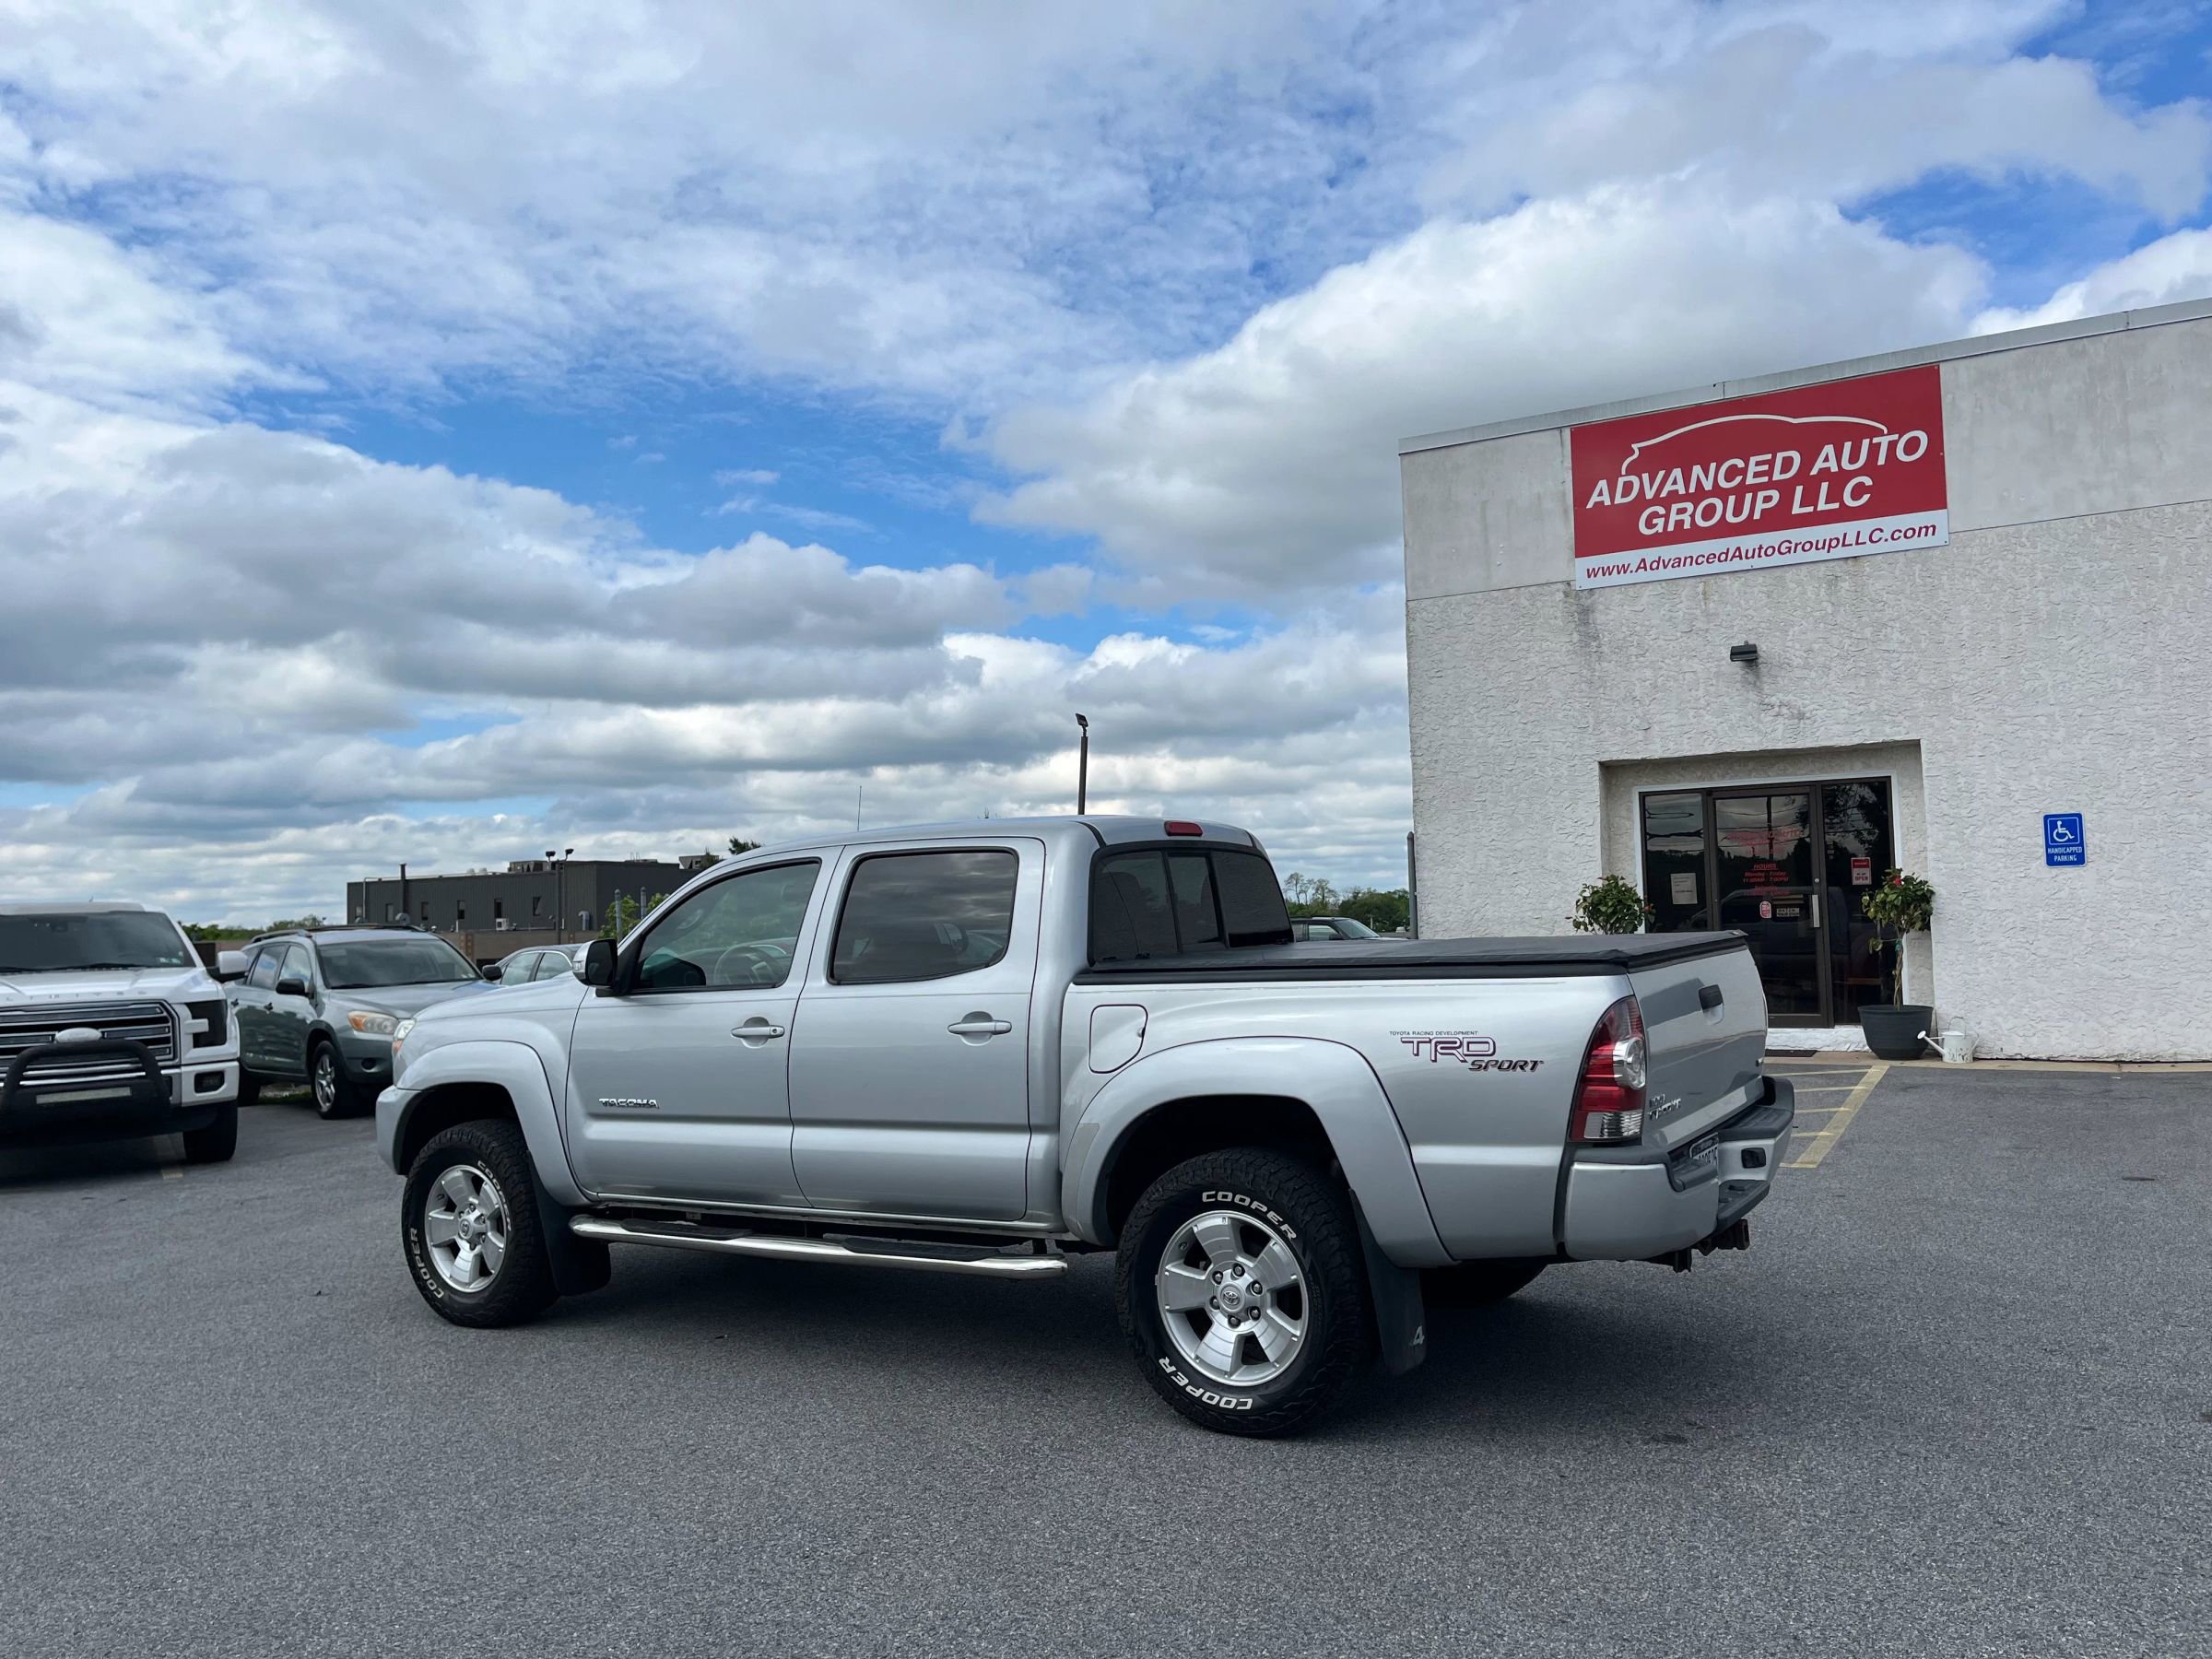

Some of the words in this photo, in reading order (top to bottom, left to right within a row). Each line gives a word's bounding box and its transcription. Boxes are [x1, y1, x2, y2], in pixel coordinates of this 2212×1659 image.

[1586, 451, 1801, 509] ADVANCED
[1809, 429, 1928, 476] AUTO
[1639, 489, 1780, 535] GROUP
[1792, 476, 1873, 515] LLC
[1586, 524, 1936, 579] www.AdvancedAutoGroupLLC.com
[1401, 1037, 1496, 1063] TRD
[1468, 1060, 1542, 1073] SPORT
[598, 1098, 660, 1109] TACOMA
[1202, 1190, 1297, 1240] COOPER
[409, 1227, 445, 1300] COOPER
[1159, 1356, 1253, 1410] COOPER
